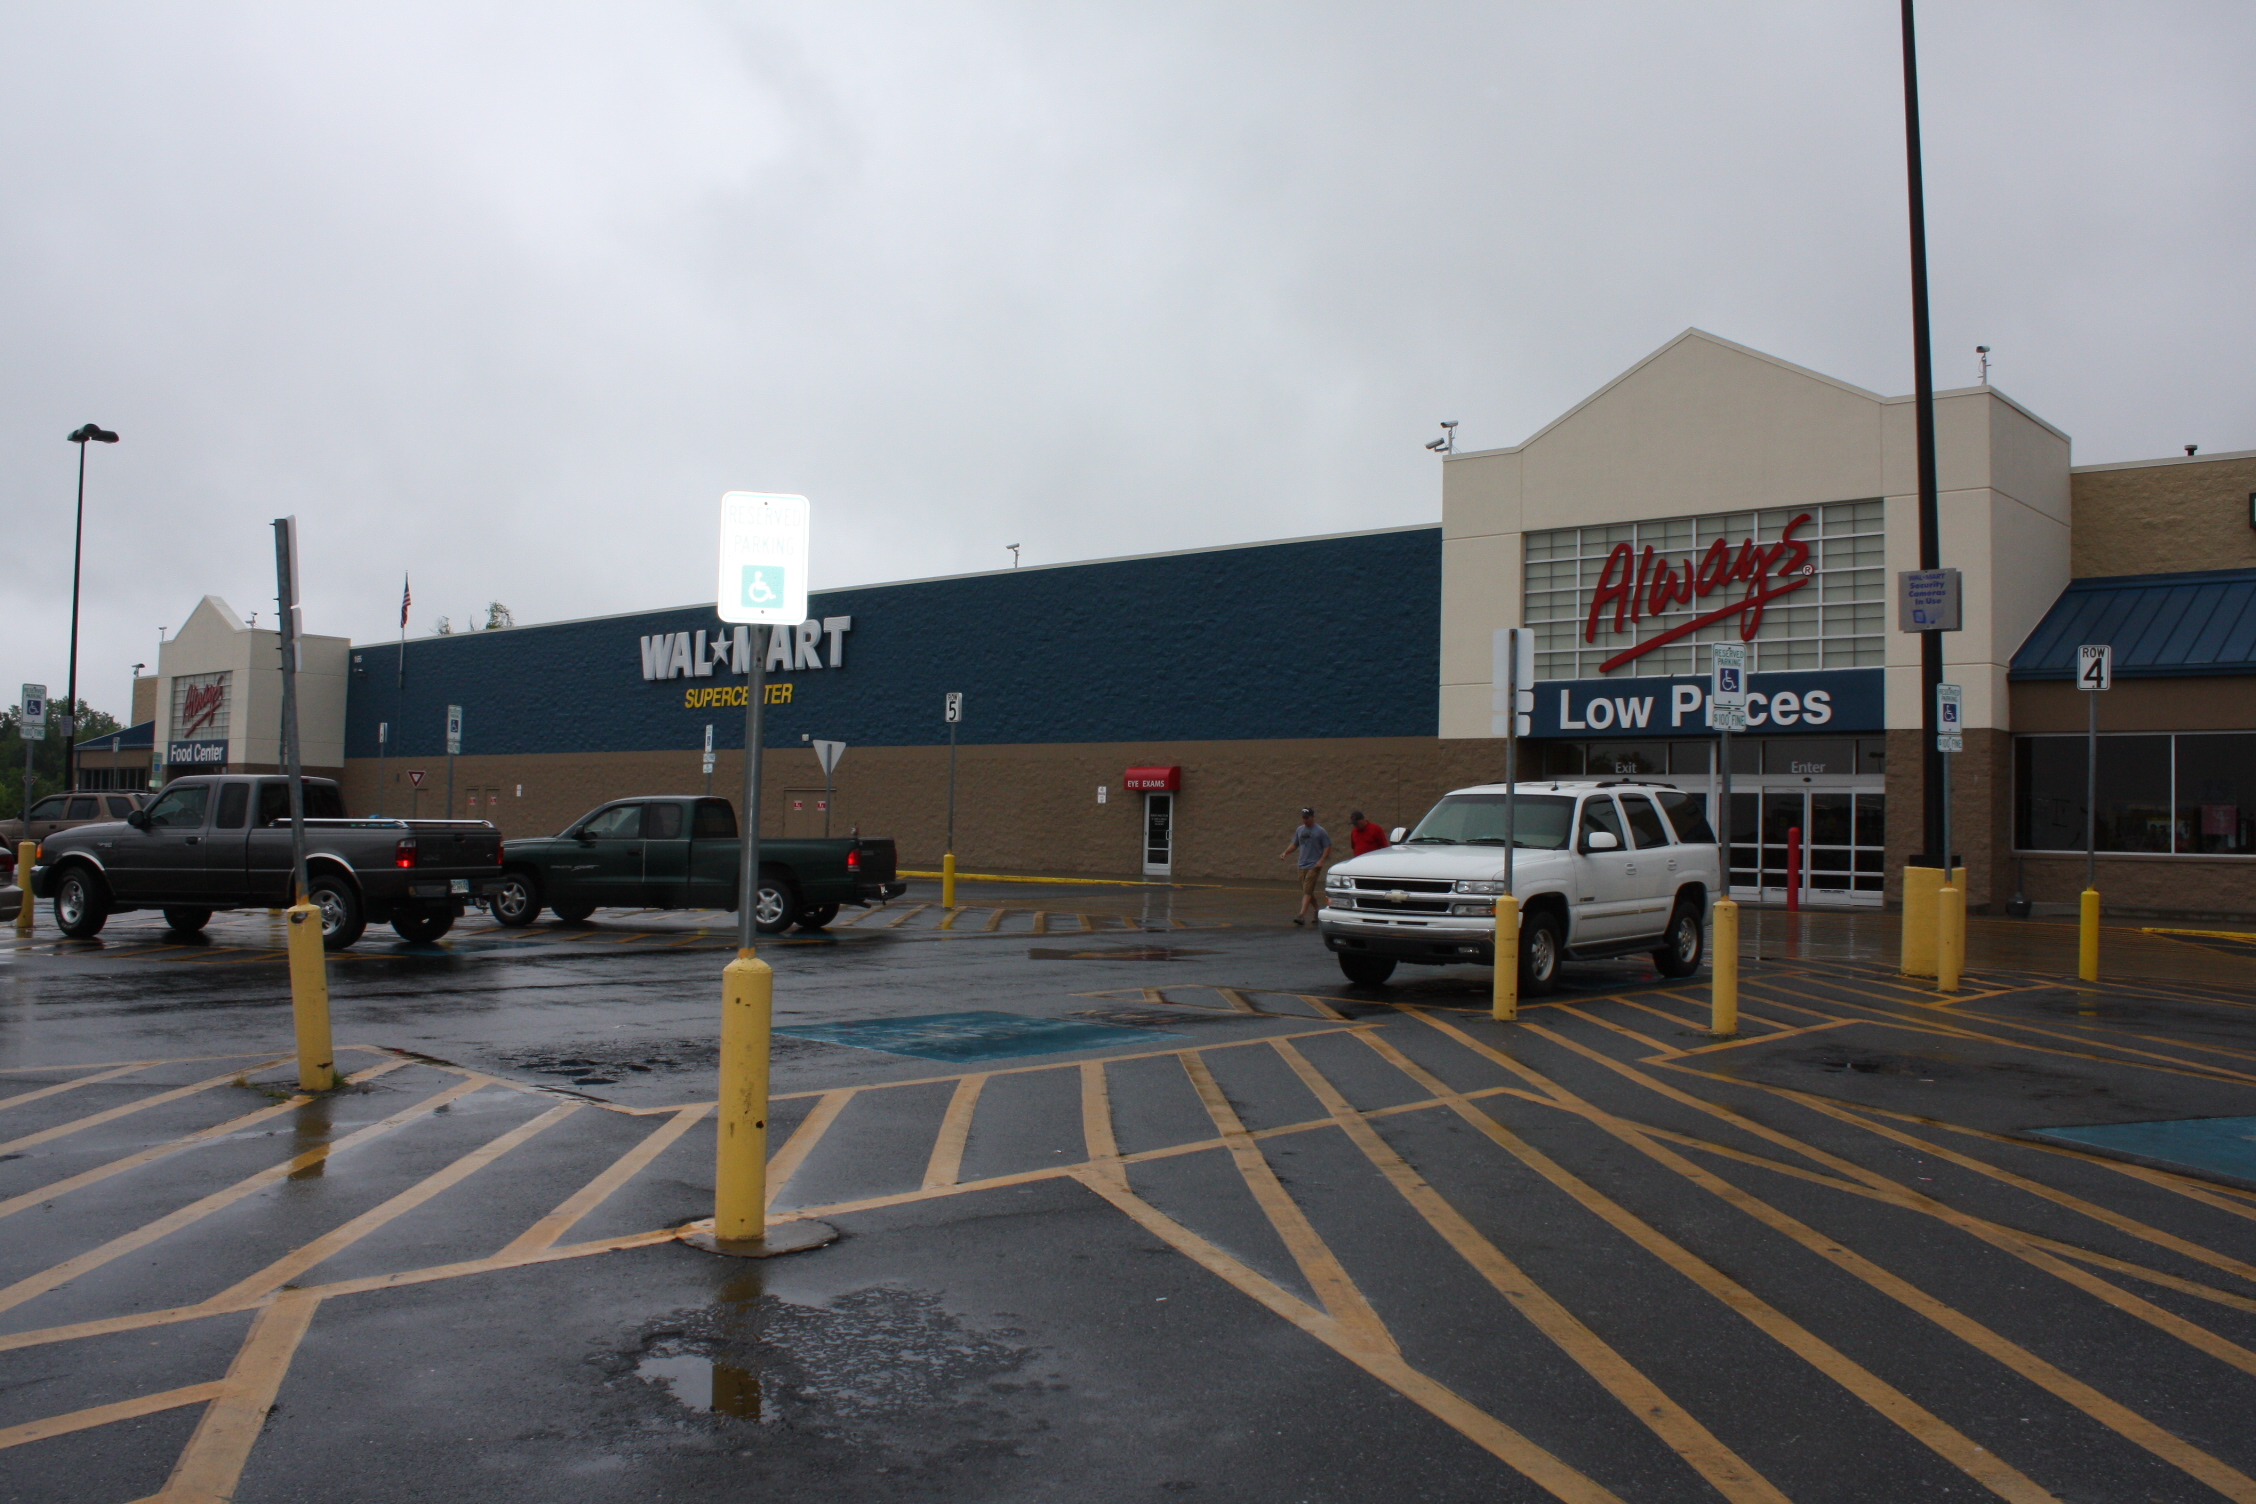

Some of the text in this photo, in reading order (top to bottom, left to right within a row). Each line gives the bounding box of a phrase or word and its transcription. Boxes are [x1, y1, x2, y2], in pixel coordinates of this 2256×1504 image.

[728, 505, 801, 526] RESERVED
[734, 535, 795, 556] PARKING
[1585, 513, 1811, 642] Always
[1910, 581, 1945, 589] Security
[1714, 649, 1744, 658] RESERVED
[2082, 647, 2105, 658] ROW
[1718, 658, 1741, 667] PARKING
[2083, 658, 2103, 688] 4
[684, 683, 794, 708] SUPERCETER
[948, 701, 957, 720] 5
[1713, 713, 1745, 726] $100 FINE
[170, 743, 224, 761] Food Center
[1615, 760, 1826, 773] Exit Enter
[1127, 780, 1165, 788] EYE EXAMS
